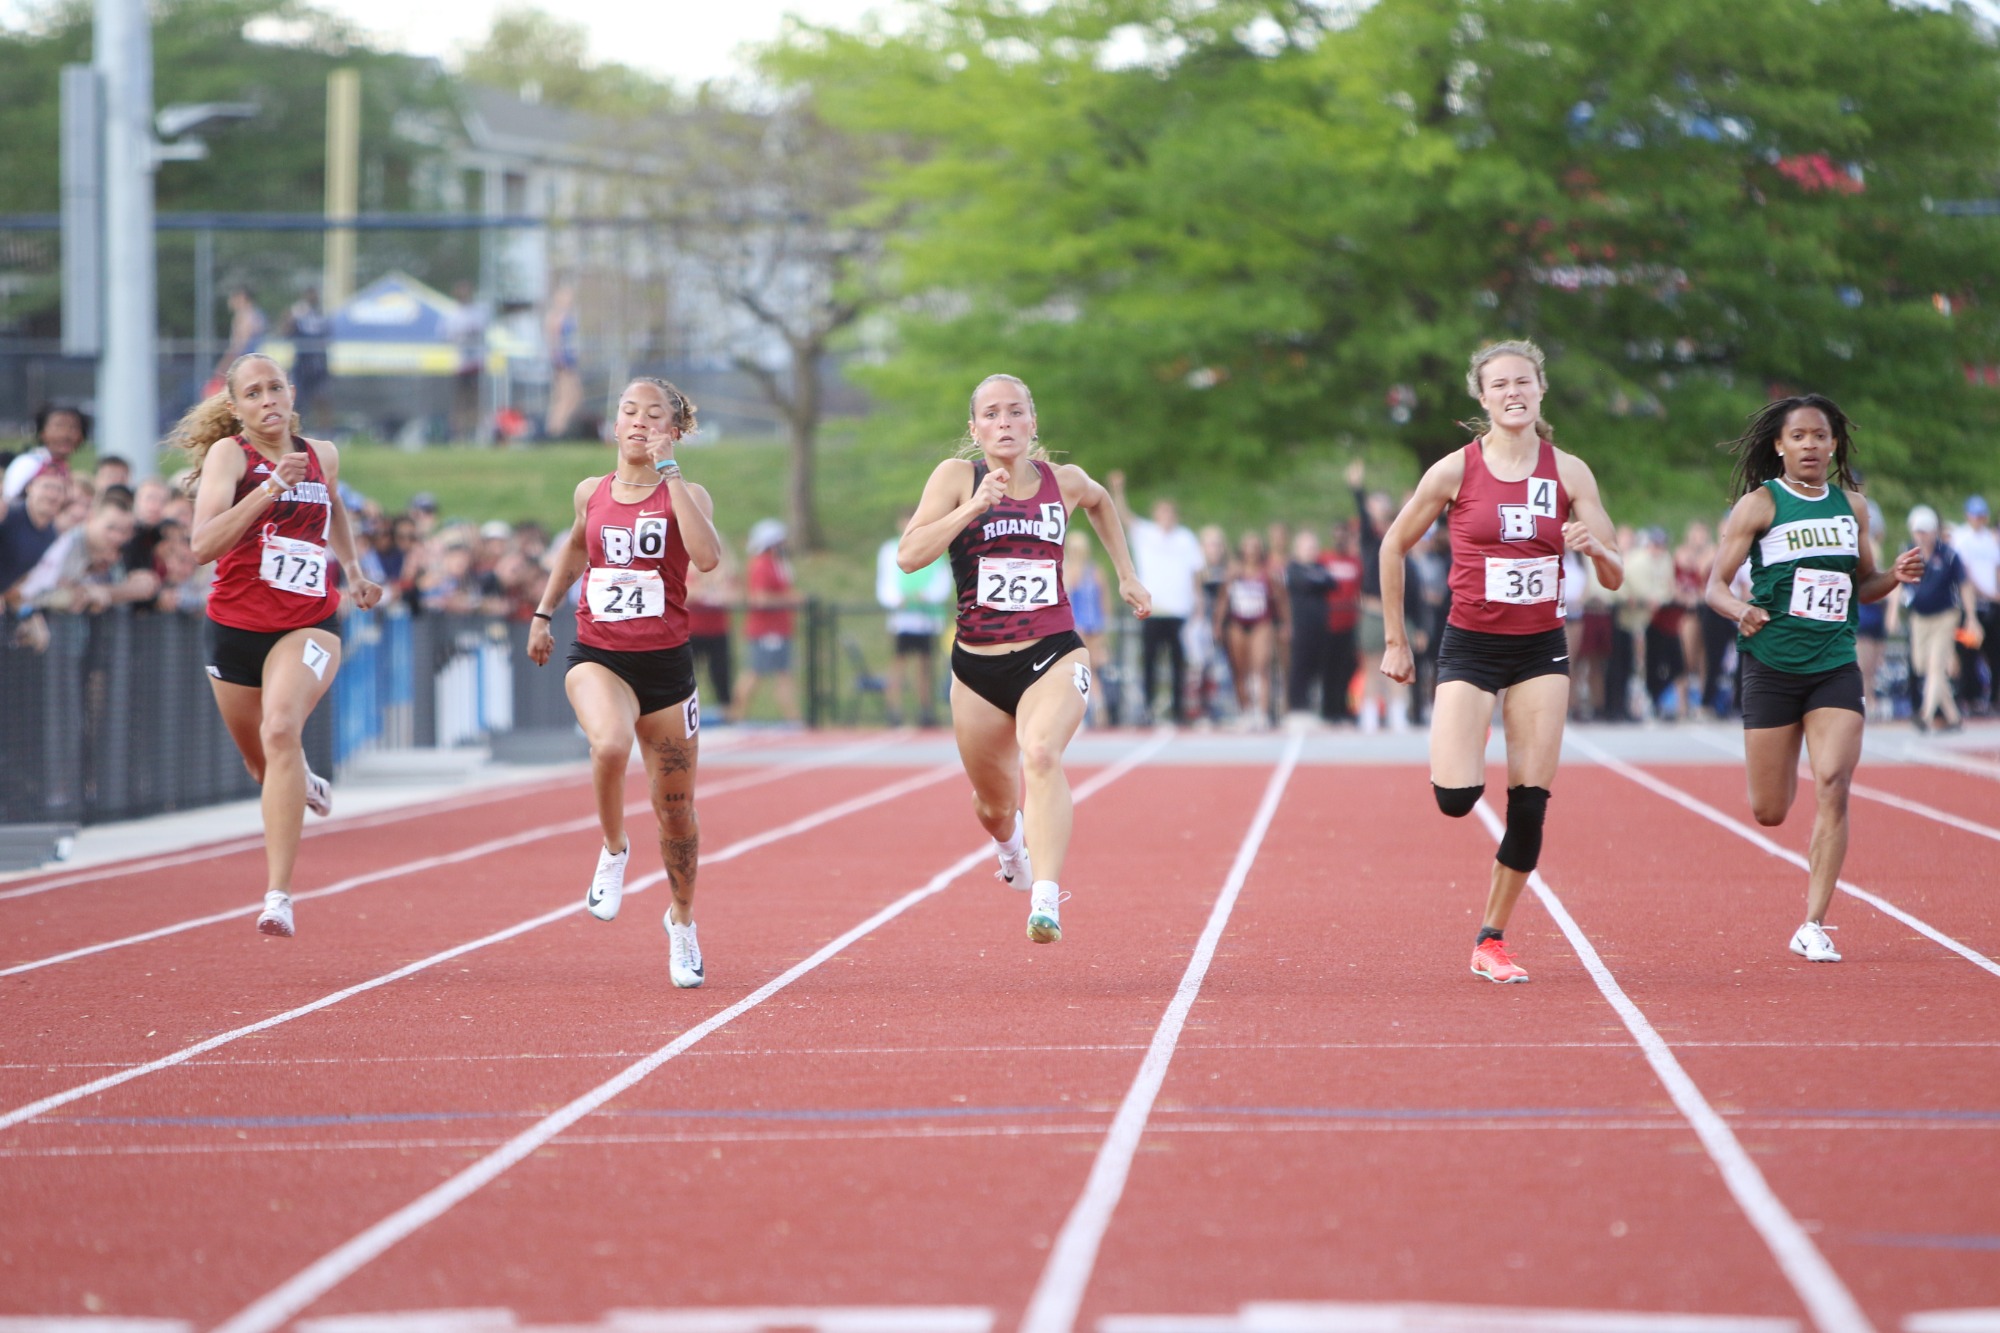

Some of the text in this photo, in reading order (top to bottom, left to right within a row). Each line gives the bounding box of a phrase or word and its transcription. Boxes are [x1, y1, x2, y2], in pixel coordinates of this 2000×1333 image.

[1533, 481, 1552, 515] 4
[638, 520, 663, 556] 6
[1047, 505, 1061, 540] 5
[1498, 504, 1537, 543] B
[1841, 518, 1856, 547] 3
[602, 525, 635, 567] B
[1786, 527, 1843, 550] HOLLI
[272, 554, 320, 588] 173
[1505, 569, 1544, 598] 36
[603, 585, 646, 614] 24
[986, 573, 1049, 604] 262
[1802, 585, 1847, 614] 145
[311, 644, 324, 667] 7
[1079, 667, 1090, 695] 5
[687, 697, 698, 732] 6
